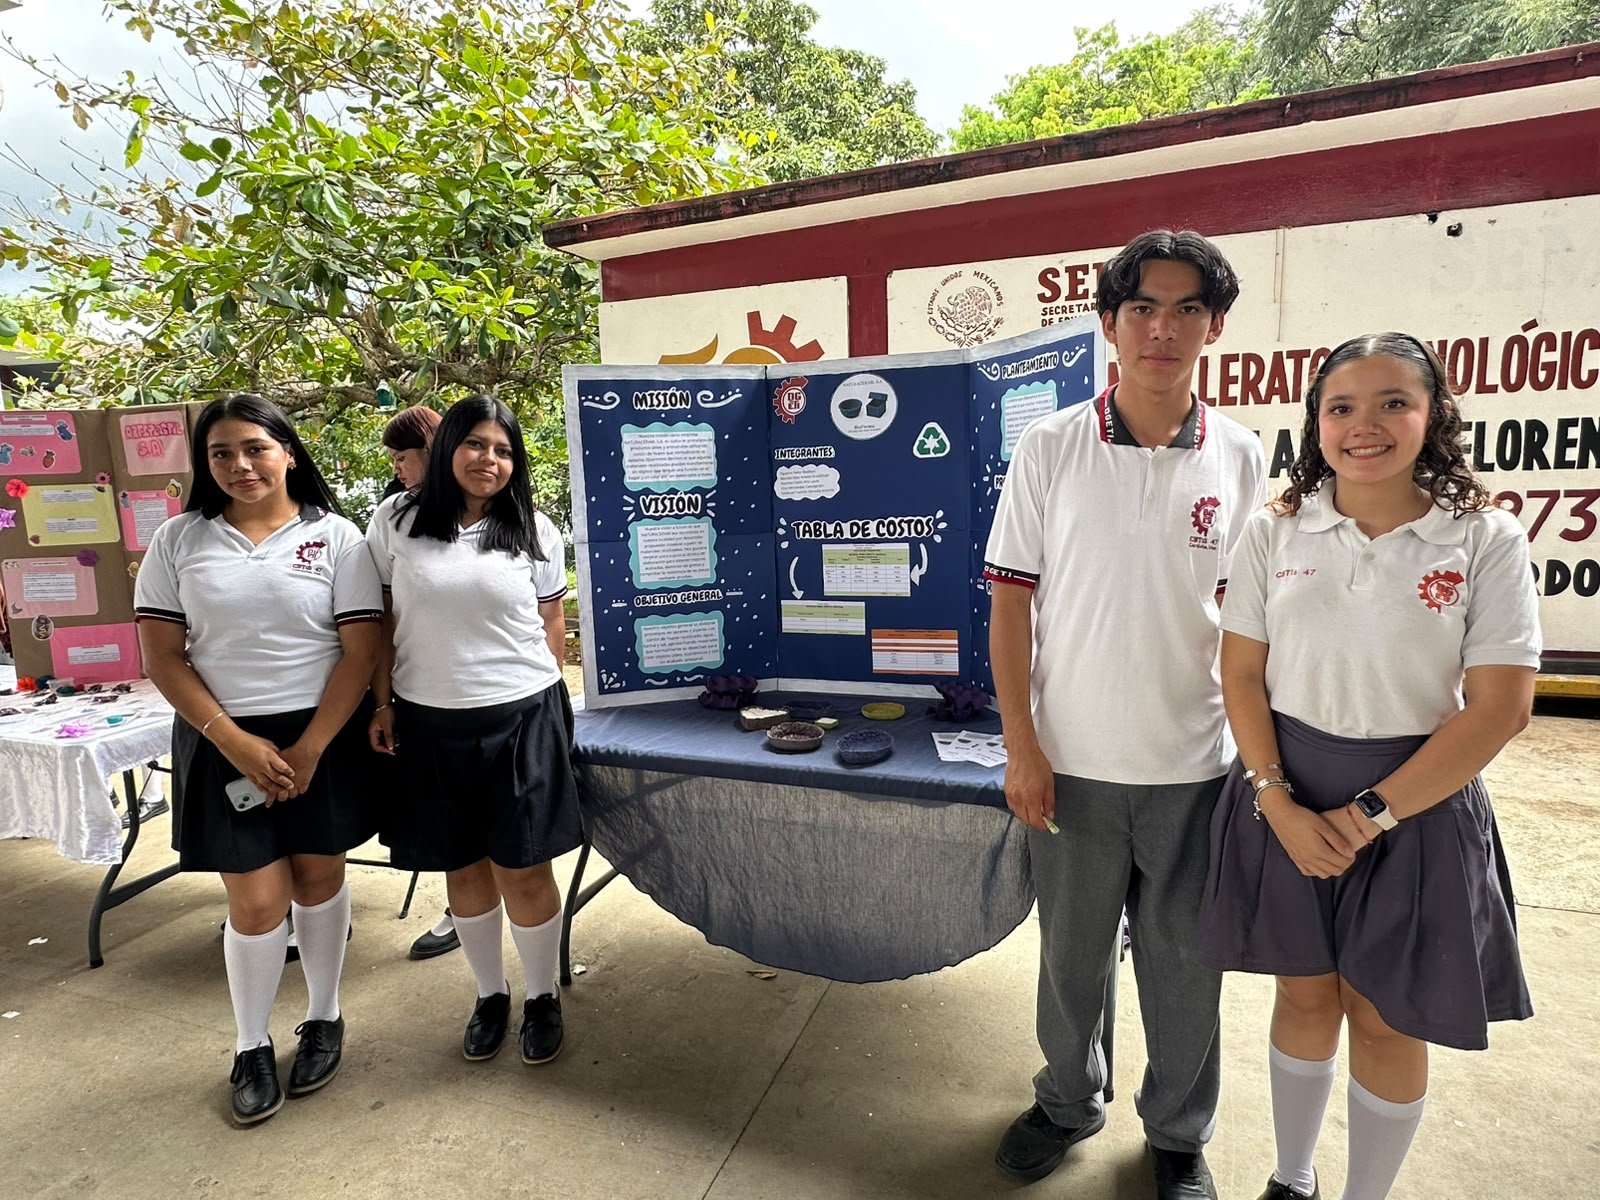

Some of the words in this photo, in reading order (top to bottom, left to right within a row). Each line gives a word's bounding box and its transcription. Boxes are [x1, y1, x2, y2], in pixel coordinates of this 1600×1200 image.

[927, 288, 939, 314] ESTADOS
[940, 270, 962, 287] UNIDOS
[973, 270, 1004, 307] MEXICANOS
[1002, 354, 1058, 377] PLANTEAMIENTO
[634, 387, 690, 409] MISIÓN
[775, 447, 833, 459] INTEGRANTES
[641, 491, 700, 514] VISIÓN
[793, 521, 844, 538] TABLA
[850, 519, 870, 537] DE
[876, 517, 933, 537] COSTOS
[1303, 568, 1316, 576] 47
[635, 594, 678, 606] OBJETIVO
[681, 590, 722, 604] GENERAL
